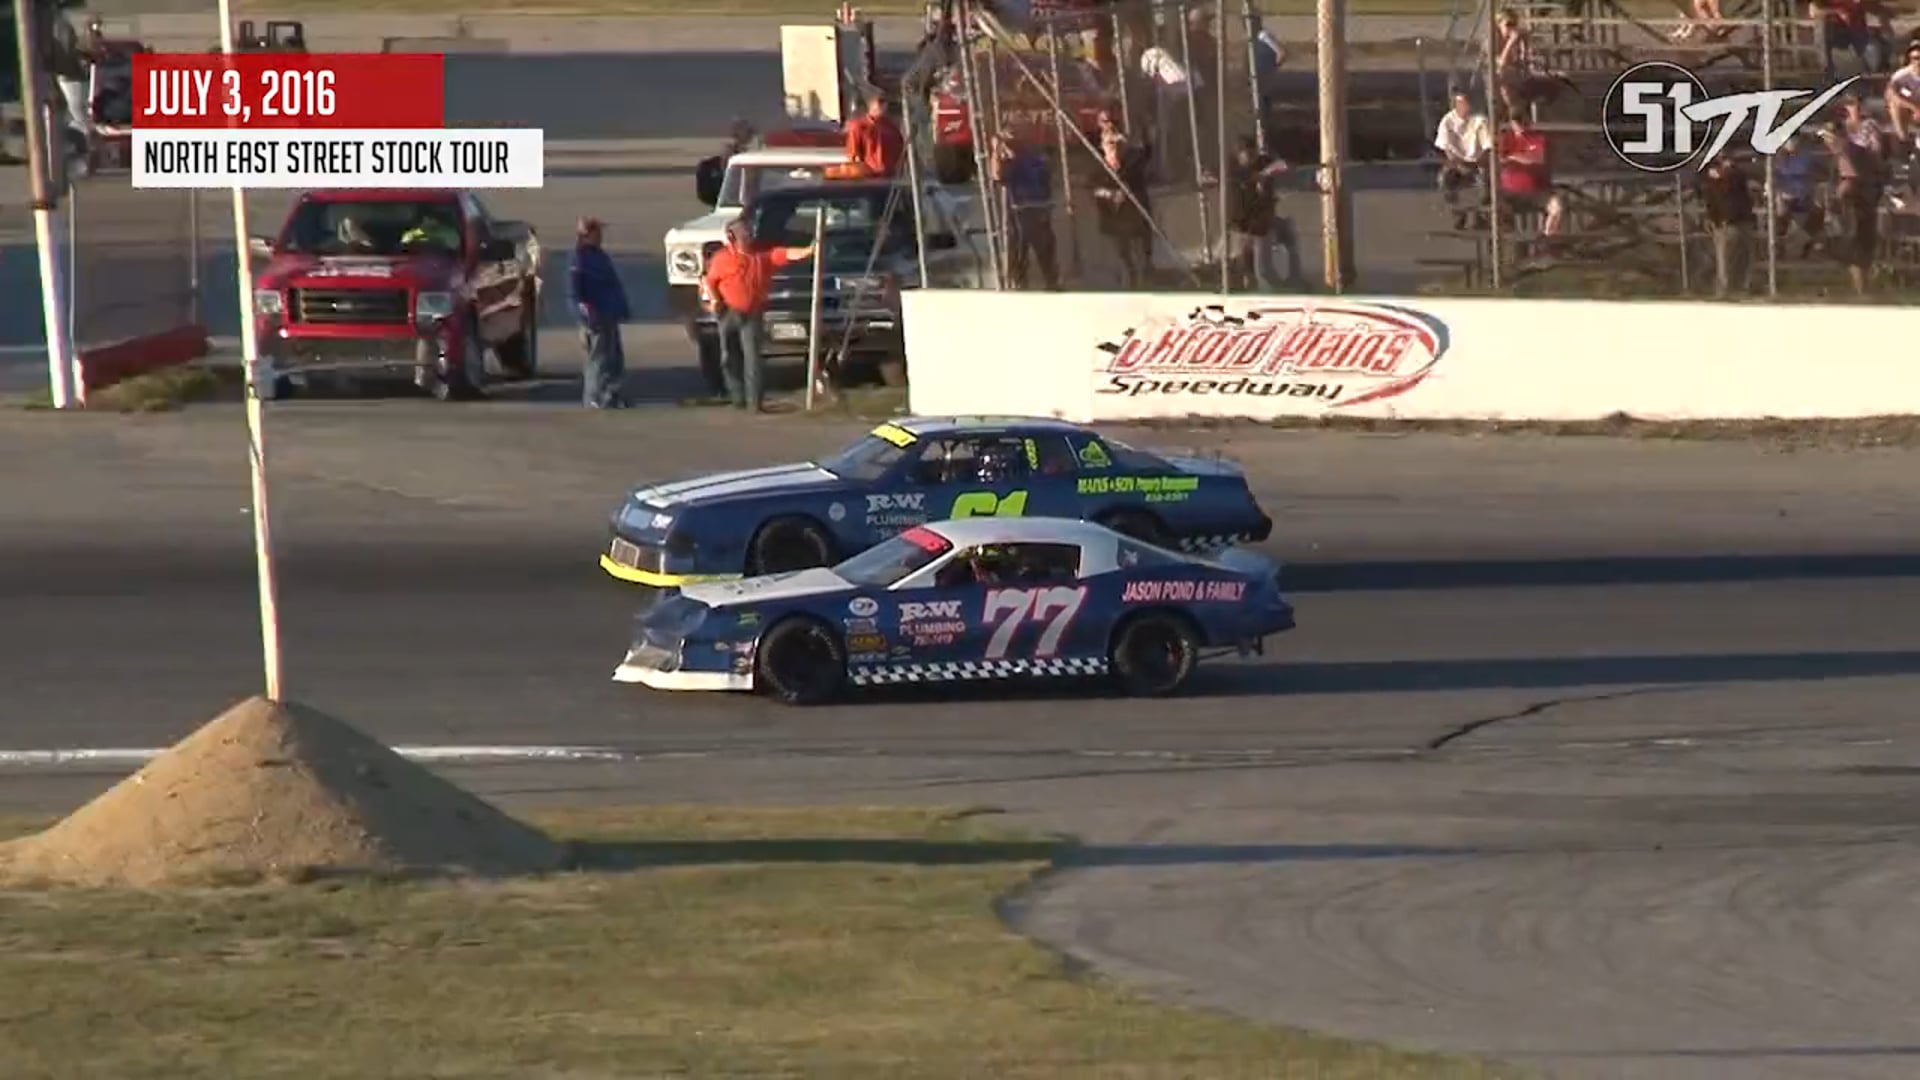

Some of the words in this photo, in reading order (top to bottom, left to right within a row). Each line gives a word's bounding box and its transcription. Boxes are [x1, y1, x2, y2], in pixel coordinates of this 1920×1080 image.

[1096, 376, 1344, 400] Speedway
[1122, 581, 1161, 601] JASON
[1162, 581, 1194, 601] POND
[1195, 581, 1204, 601] &
[1205, 581, 1246, 601] FAMILY
[900, 622, 966, 636] PLUMBING
[982, 586, 1087, 658] 77
